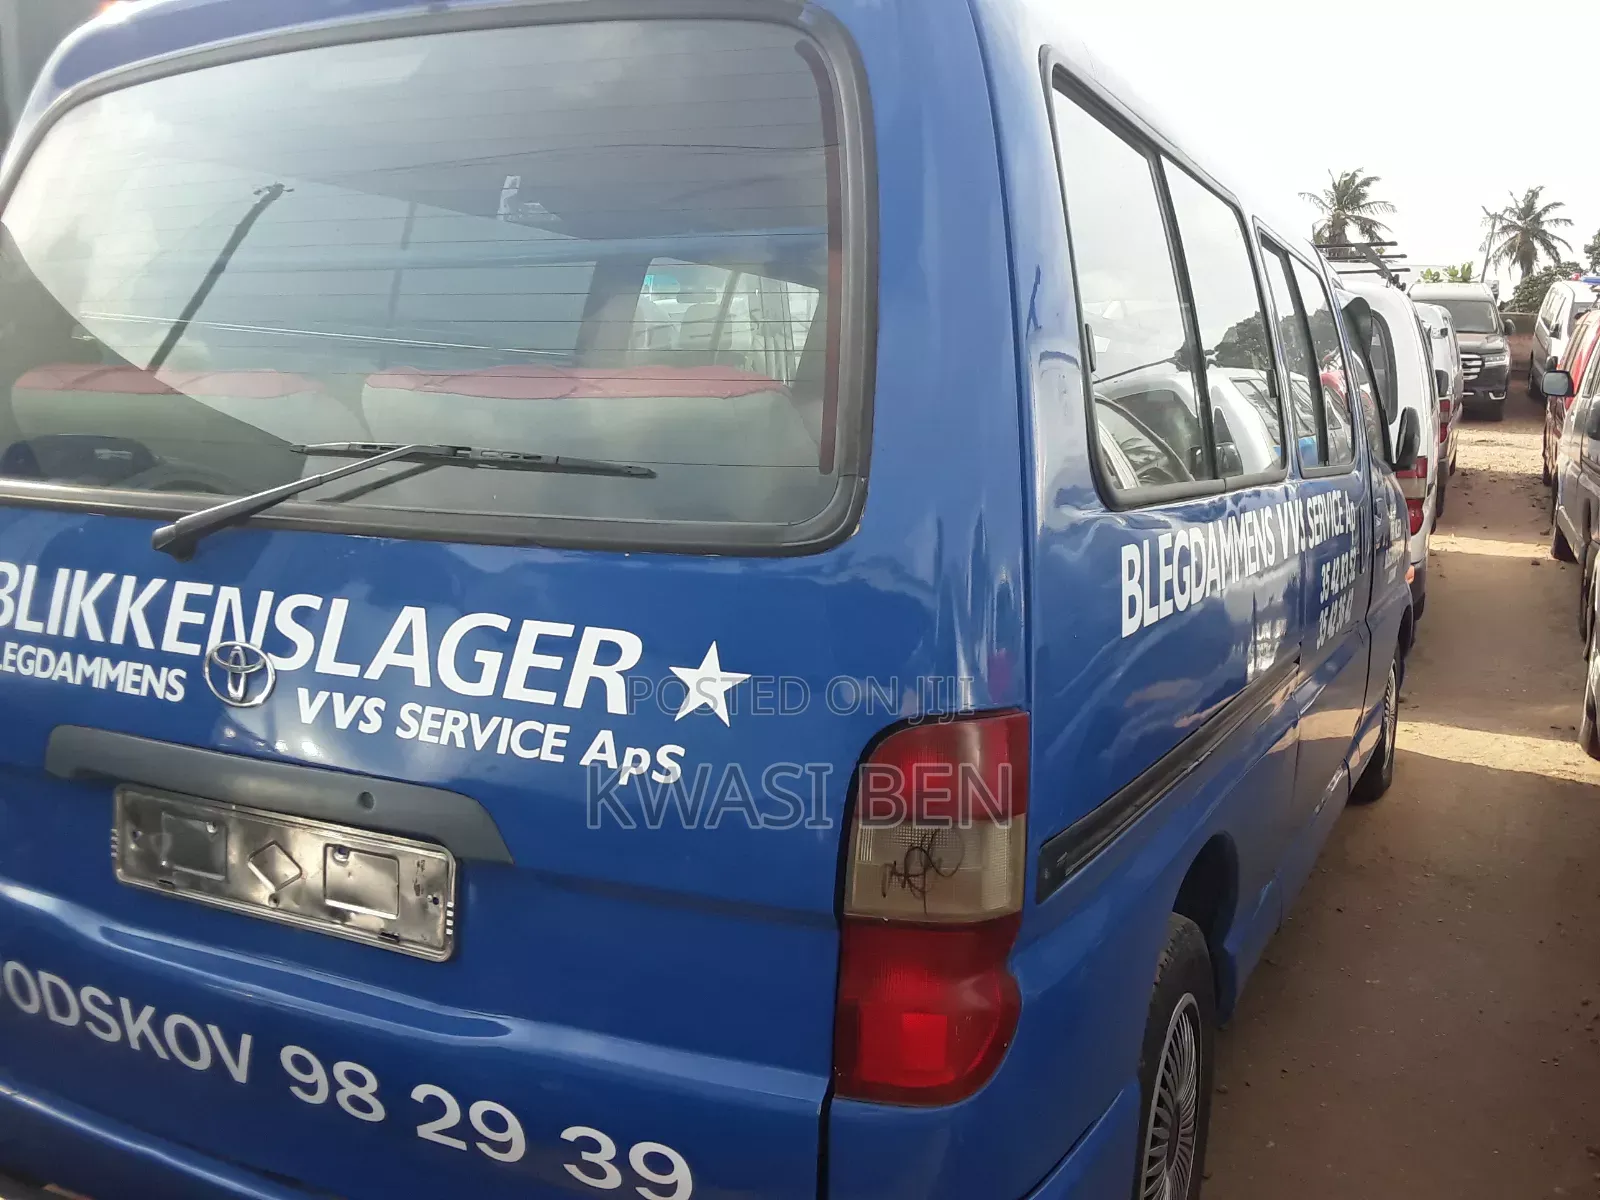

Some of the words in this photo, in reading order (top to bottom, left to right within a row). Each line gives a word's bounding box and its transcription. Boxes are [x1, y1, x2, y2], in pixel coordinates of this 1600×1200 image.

[0, 562, 643, 715] BLIKKENSLAGER
[1121, 506, 1276, 639] BLEGDAMMENS
[1275, 498, 1305, 560] VVS
[1306, 490, 1344, 549] SERVICE
[0, 641, 187, 702] EGDAMMENS
[297, 687, 386, 734] VVS
[396, 702, 571, 763] SERVICE
[579, 729, 686, 785] ApS
[280, 1044, 386, 1122] 98
[410, 1083, 526, 1163] 29
[560, 1126, 693, 1200] 39
